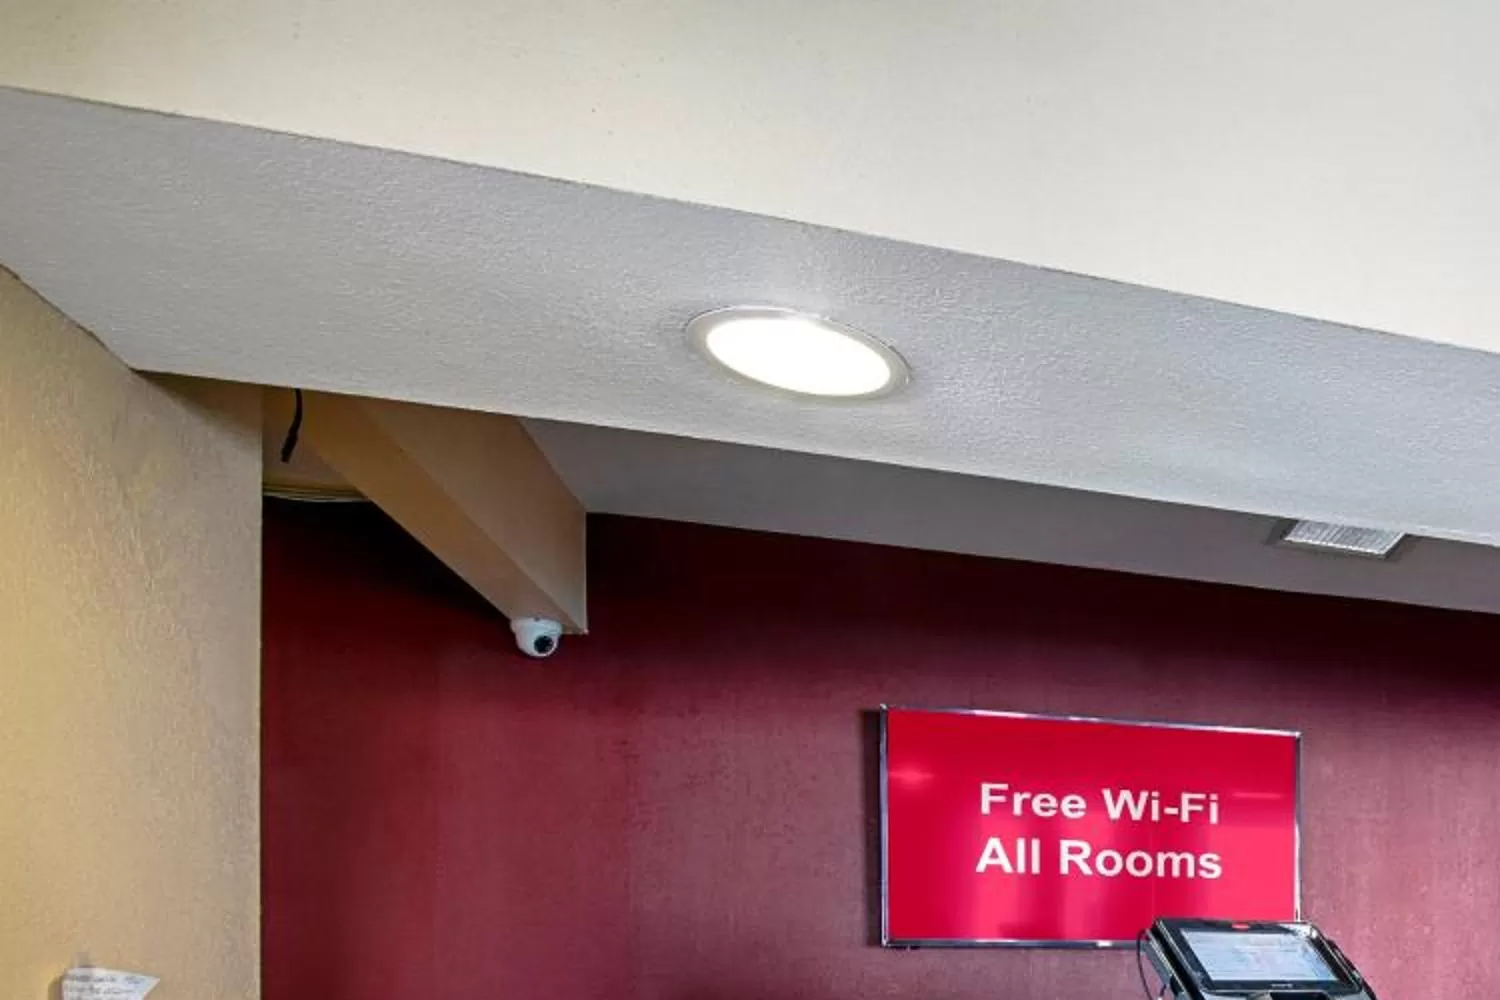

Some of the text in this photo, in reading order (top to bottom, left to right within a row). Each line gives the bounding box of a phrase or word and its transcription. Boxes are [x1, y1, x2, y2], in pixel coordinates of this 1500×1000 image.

[980, 782, 1218, 824] Free Wi-Fi
[975, 837, 1222, 879] All Rooms
